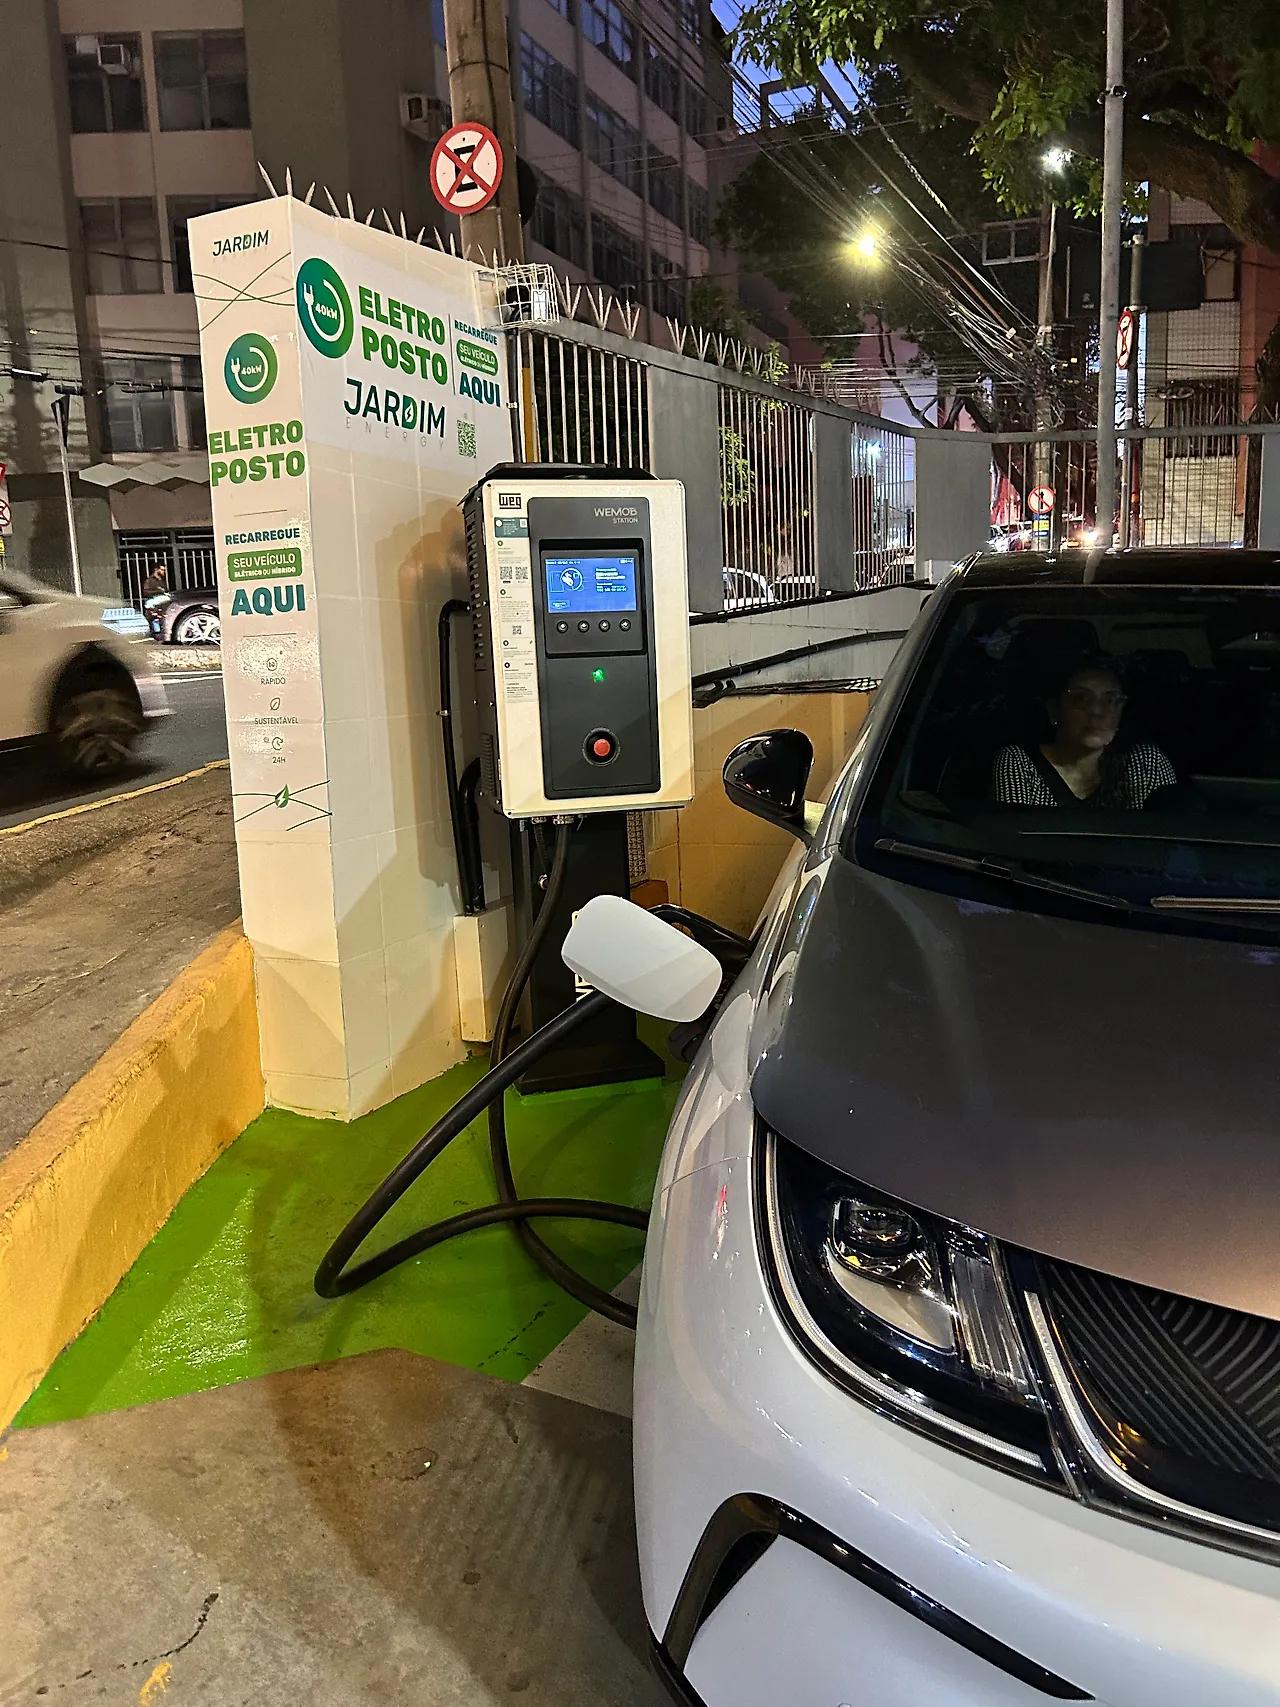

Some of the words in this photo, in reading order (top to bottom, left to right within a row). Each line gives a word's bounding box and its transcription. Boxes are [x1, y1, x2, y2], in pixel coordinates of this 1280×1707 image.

[212, 230, 269, 256] JARDIM
[358, 285, 446, 346] ELETRO
[454, 319, 498, 346] RECARREGUE
[361, 326, 448, 386] POSTO
[459, 371, 501, 408] AQUI
[344, 377, 446, 438] JARDIM
[209, 420, 303, 455] ELETRO
[211, 450, 305, 487] POSTO
[593, 507, 638, 517] WEMOB
[225, 527, 301, 545] RECARREGUE
[233, 557, 252, 568] SEU
[254, 553, 296, 567] VEÍCULO
[231, 584, 306, 616] AQUI
[272, 756, 286, 764] 24H
